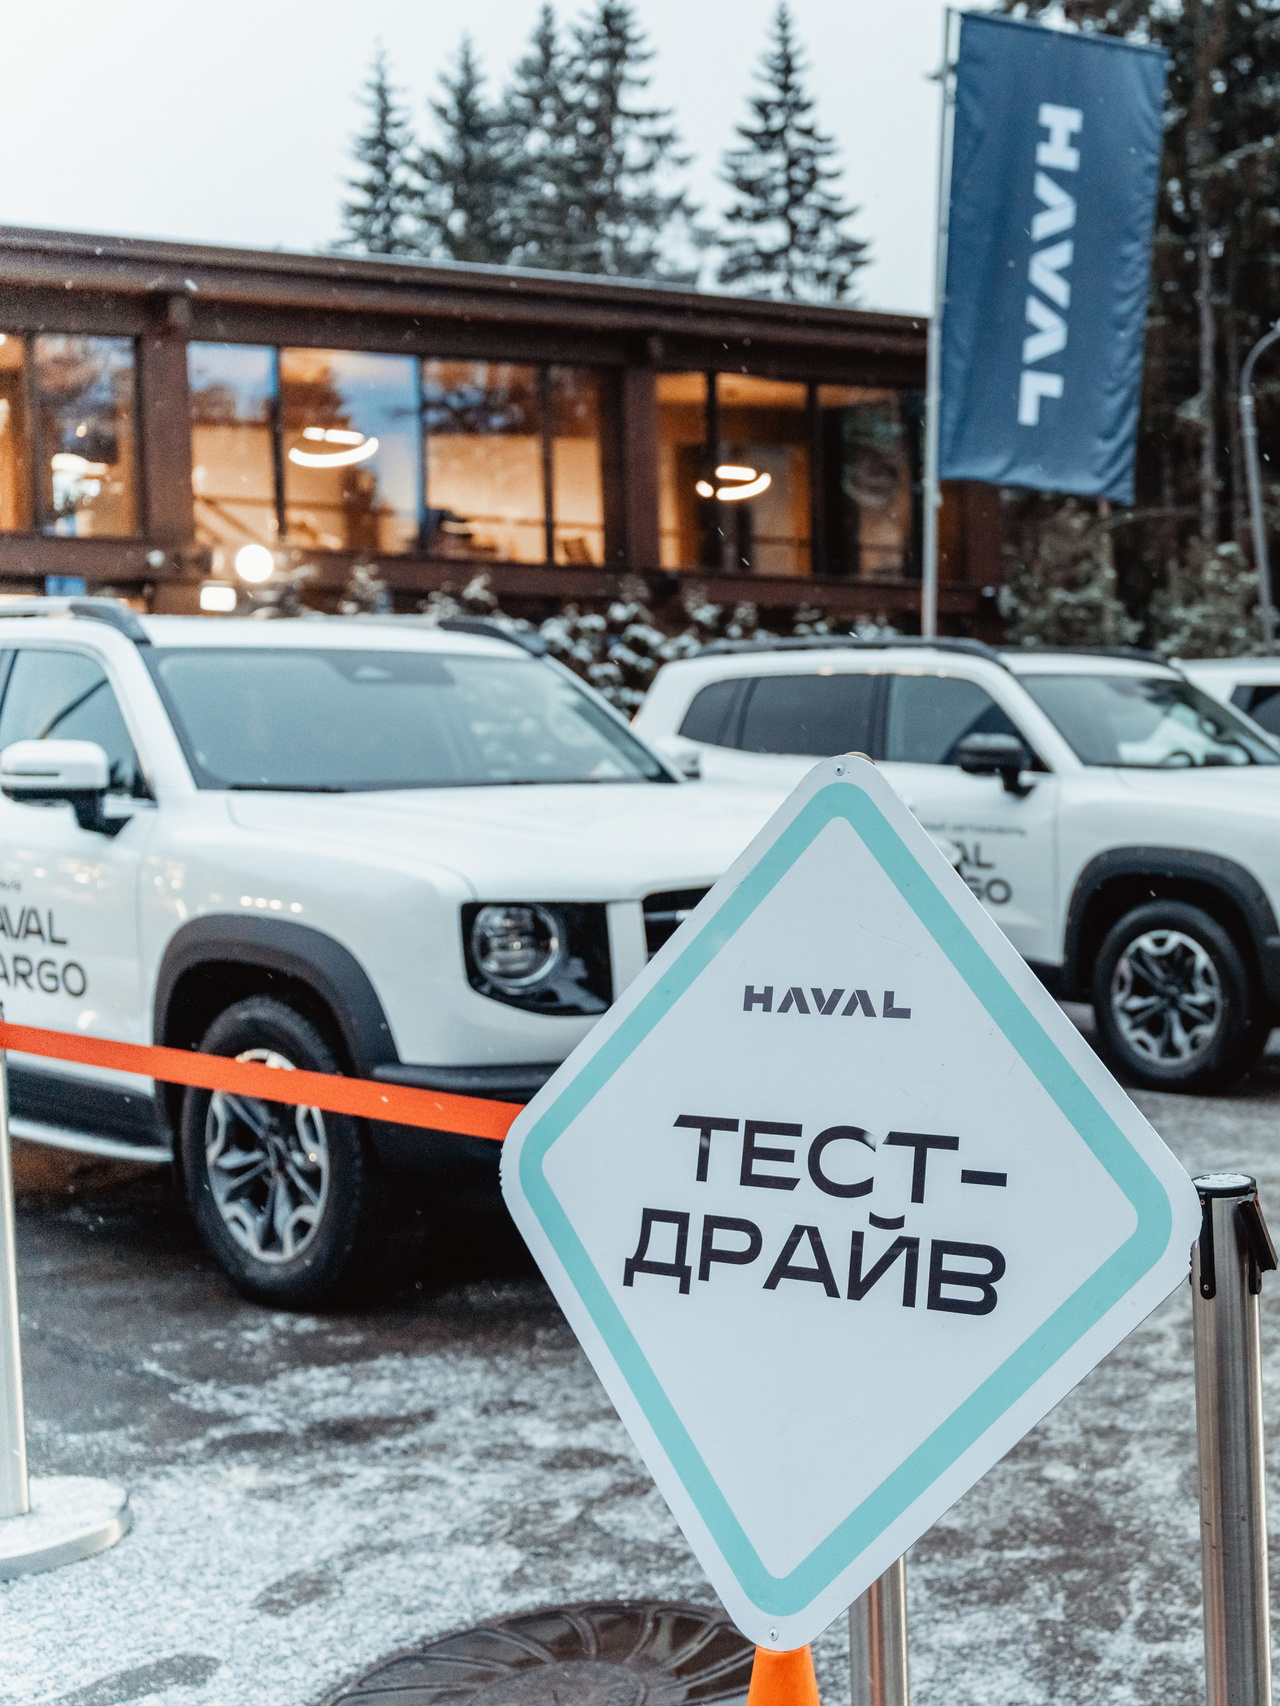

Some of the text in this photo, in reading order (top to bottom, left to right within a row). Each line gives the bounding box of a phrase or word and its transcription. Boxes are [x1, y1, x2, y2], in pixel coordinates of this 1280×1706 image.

[1017, 102, 1083, 426] HAVAL
[743, 985, 911, 1019] HAVAL
[673, 1114, 1008, 1204] ТЕСТ-
[623, 1207, 1007, 1316] ДРАЙВ
